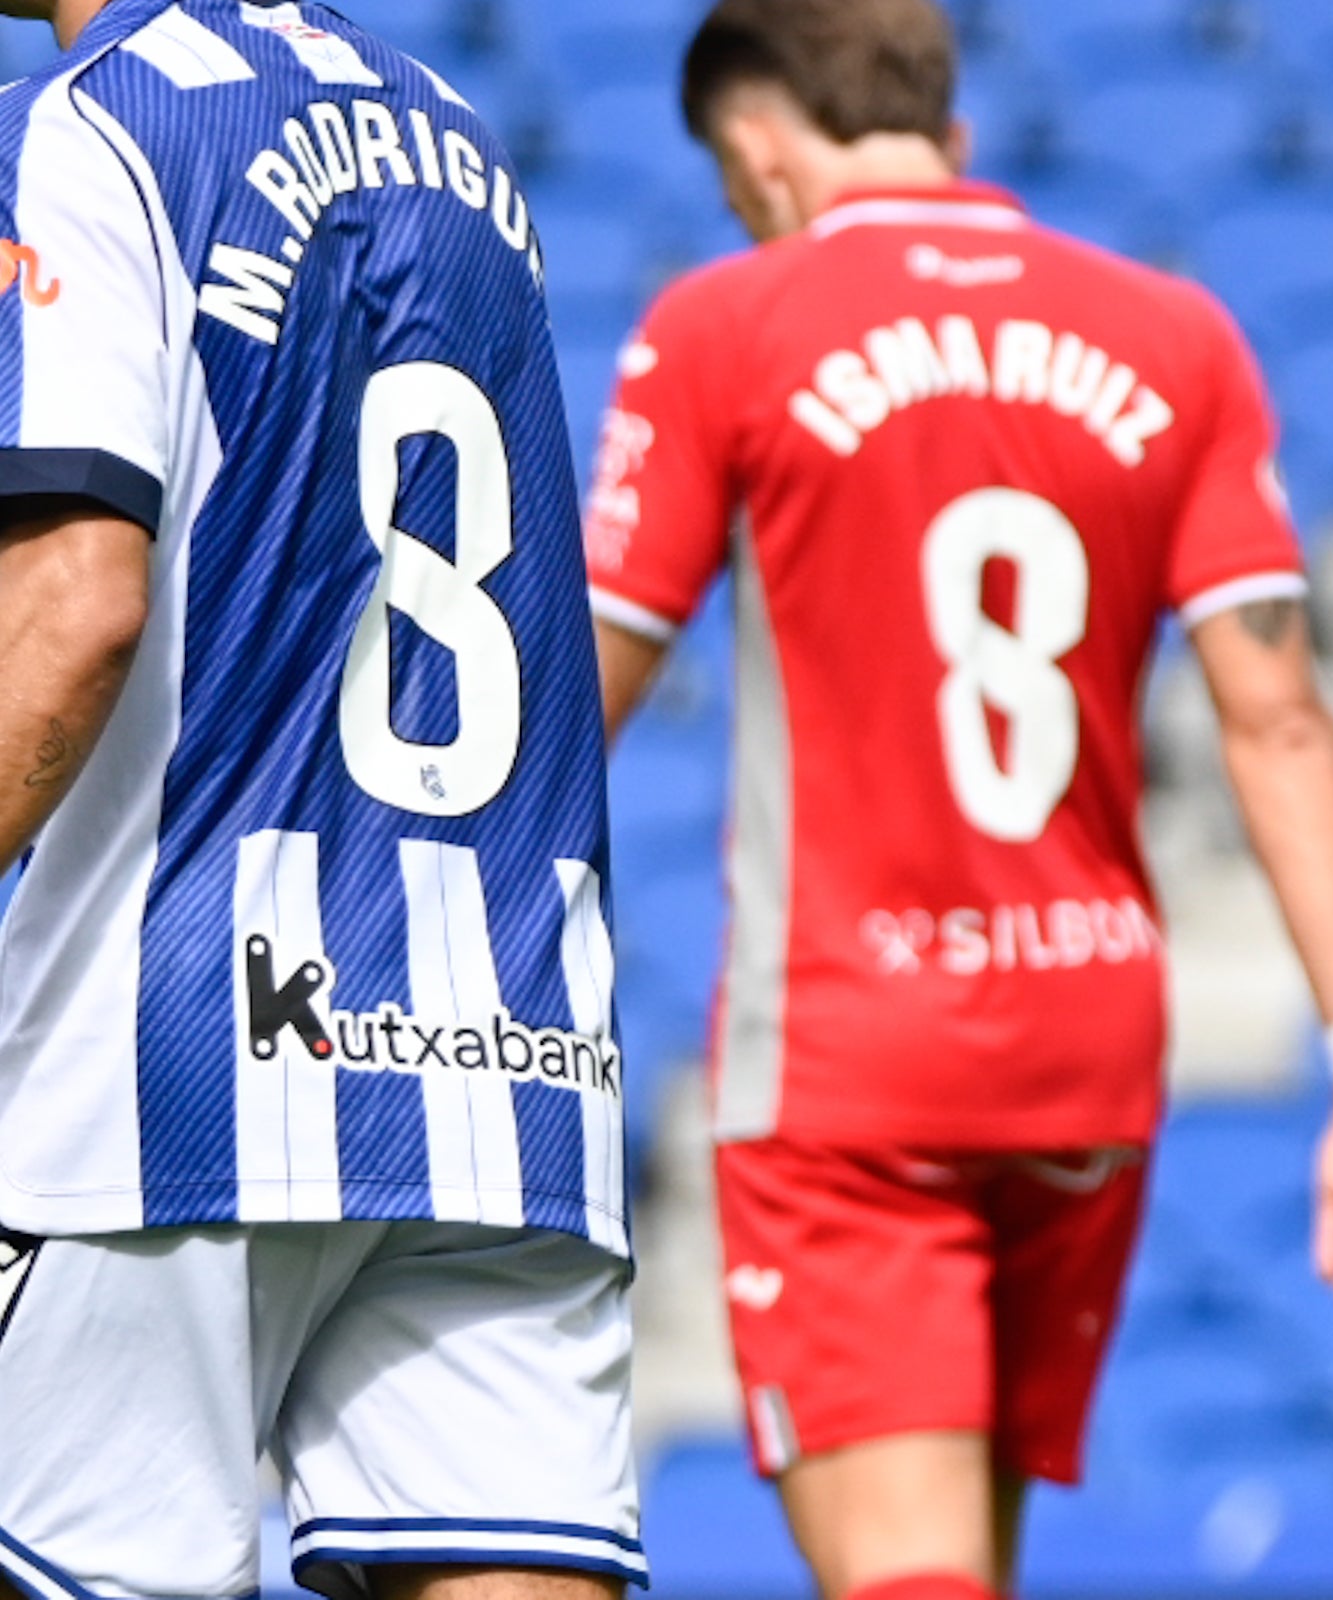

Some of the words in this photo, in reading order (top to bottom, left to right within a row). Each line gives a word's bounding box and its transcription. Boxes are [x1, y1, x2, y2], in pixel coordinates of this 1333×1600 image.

[338, 359, 522, 818] 8
[920, 485, 1089, 844] 8
[246, 933, 618, 1098] Kutxabank
